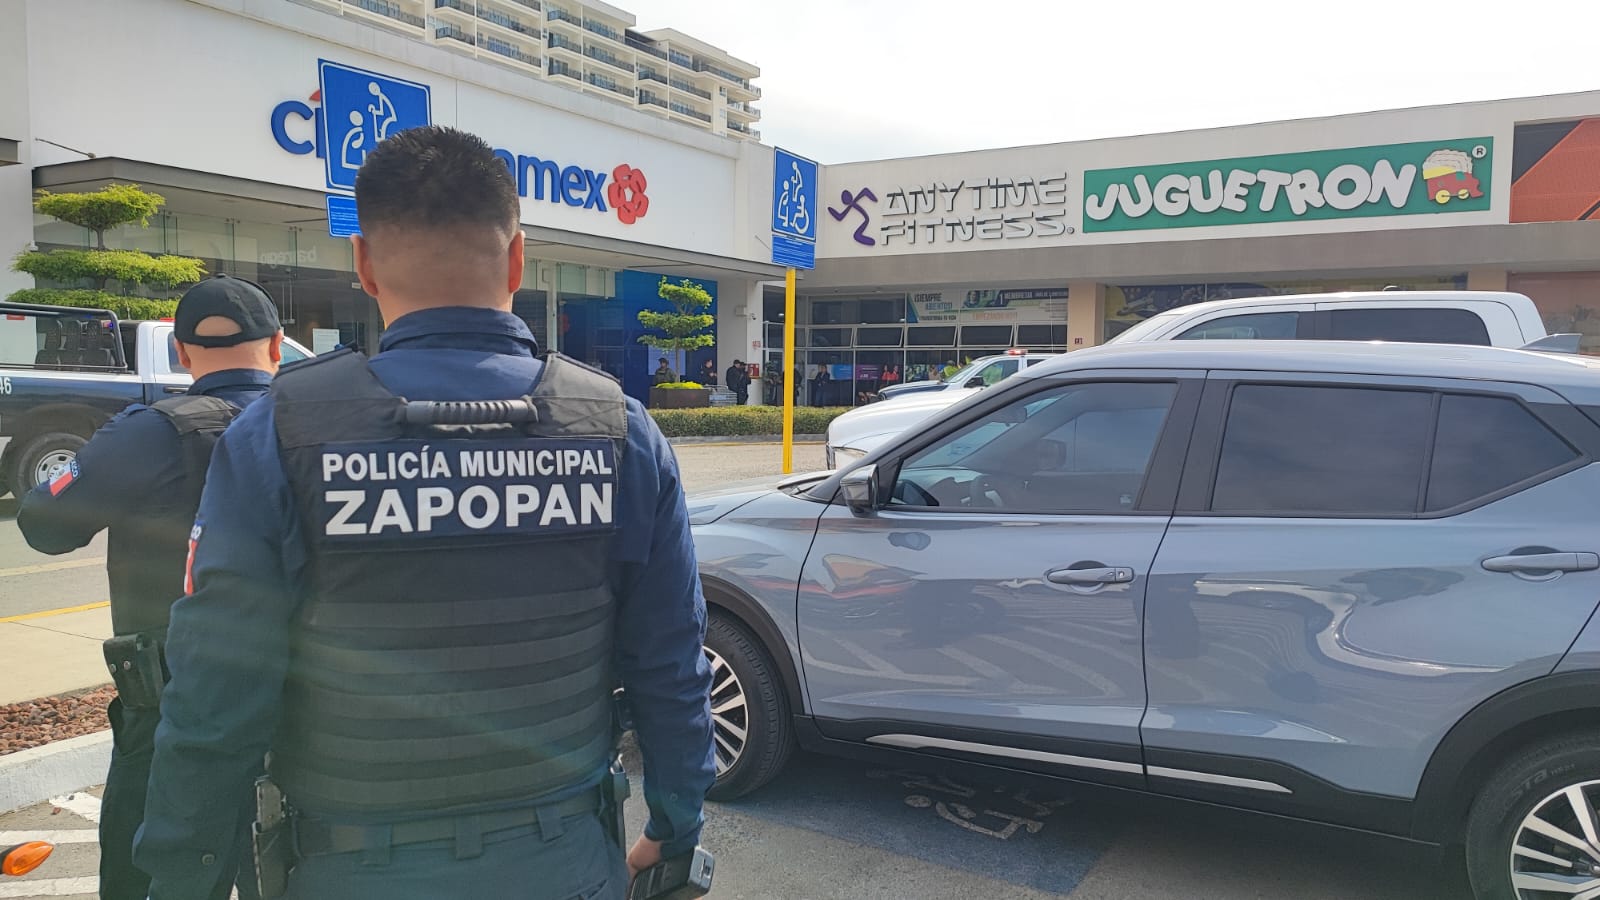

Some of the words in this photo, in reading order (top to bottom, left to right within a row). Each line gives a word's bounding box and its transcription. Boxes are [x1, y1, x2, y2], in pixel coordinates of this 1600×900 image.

[880, 171, 1067, 216] ANYTIME
[1085, 158, 1417, 222] JUGUETRON
[880, 208, 1066, 246] FITNESS
[322, 445, 452, 481] POLICÍA
[460, 449, 613, 478] MUNICIPAL
[324, 482, 613, 536] ZAPOPAN
